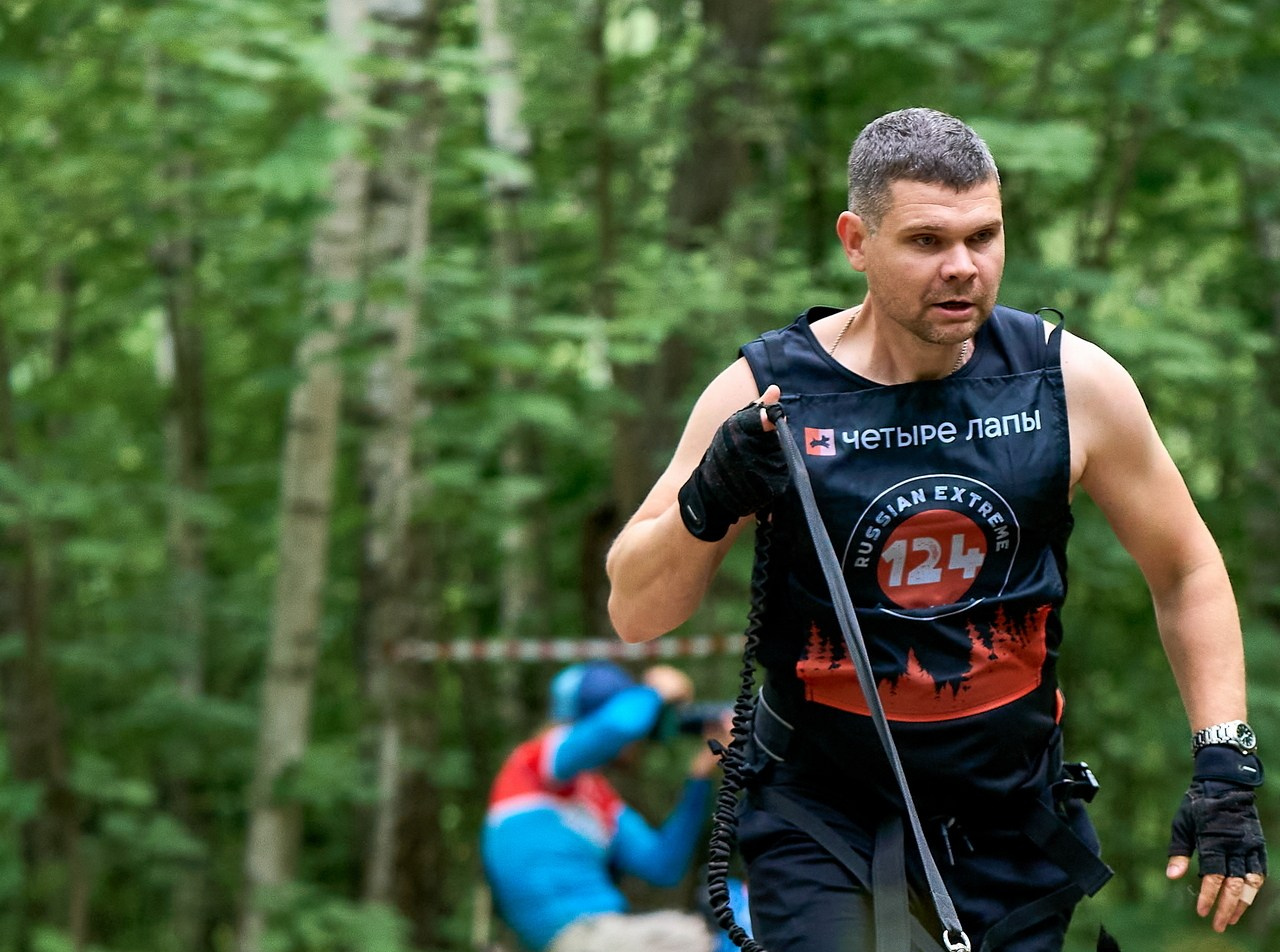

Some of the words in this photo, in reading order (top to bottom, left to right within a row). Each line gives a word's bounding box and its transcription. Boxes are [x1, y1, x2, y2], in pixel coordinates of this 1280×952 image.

[842, 421, 957, 449] четыре
[966, 410, 1041, 440] лапы
[855, 488, 927, 567] RUSSIAN
[934, 486, 1009, 552] EXTREME
[881, 534, 985, 587] 124
